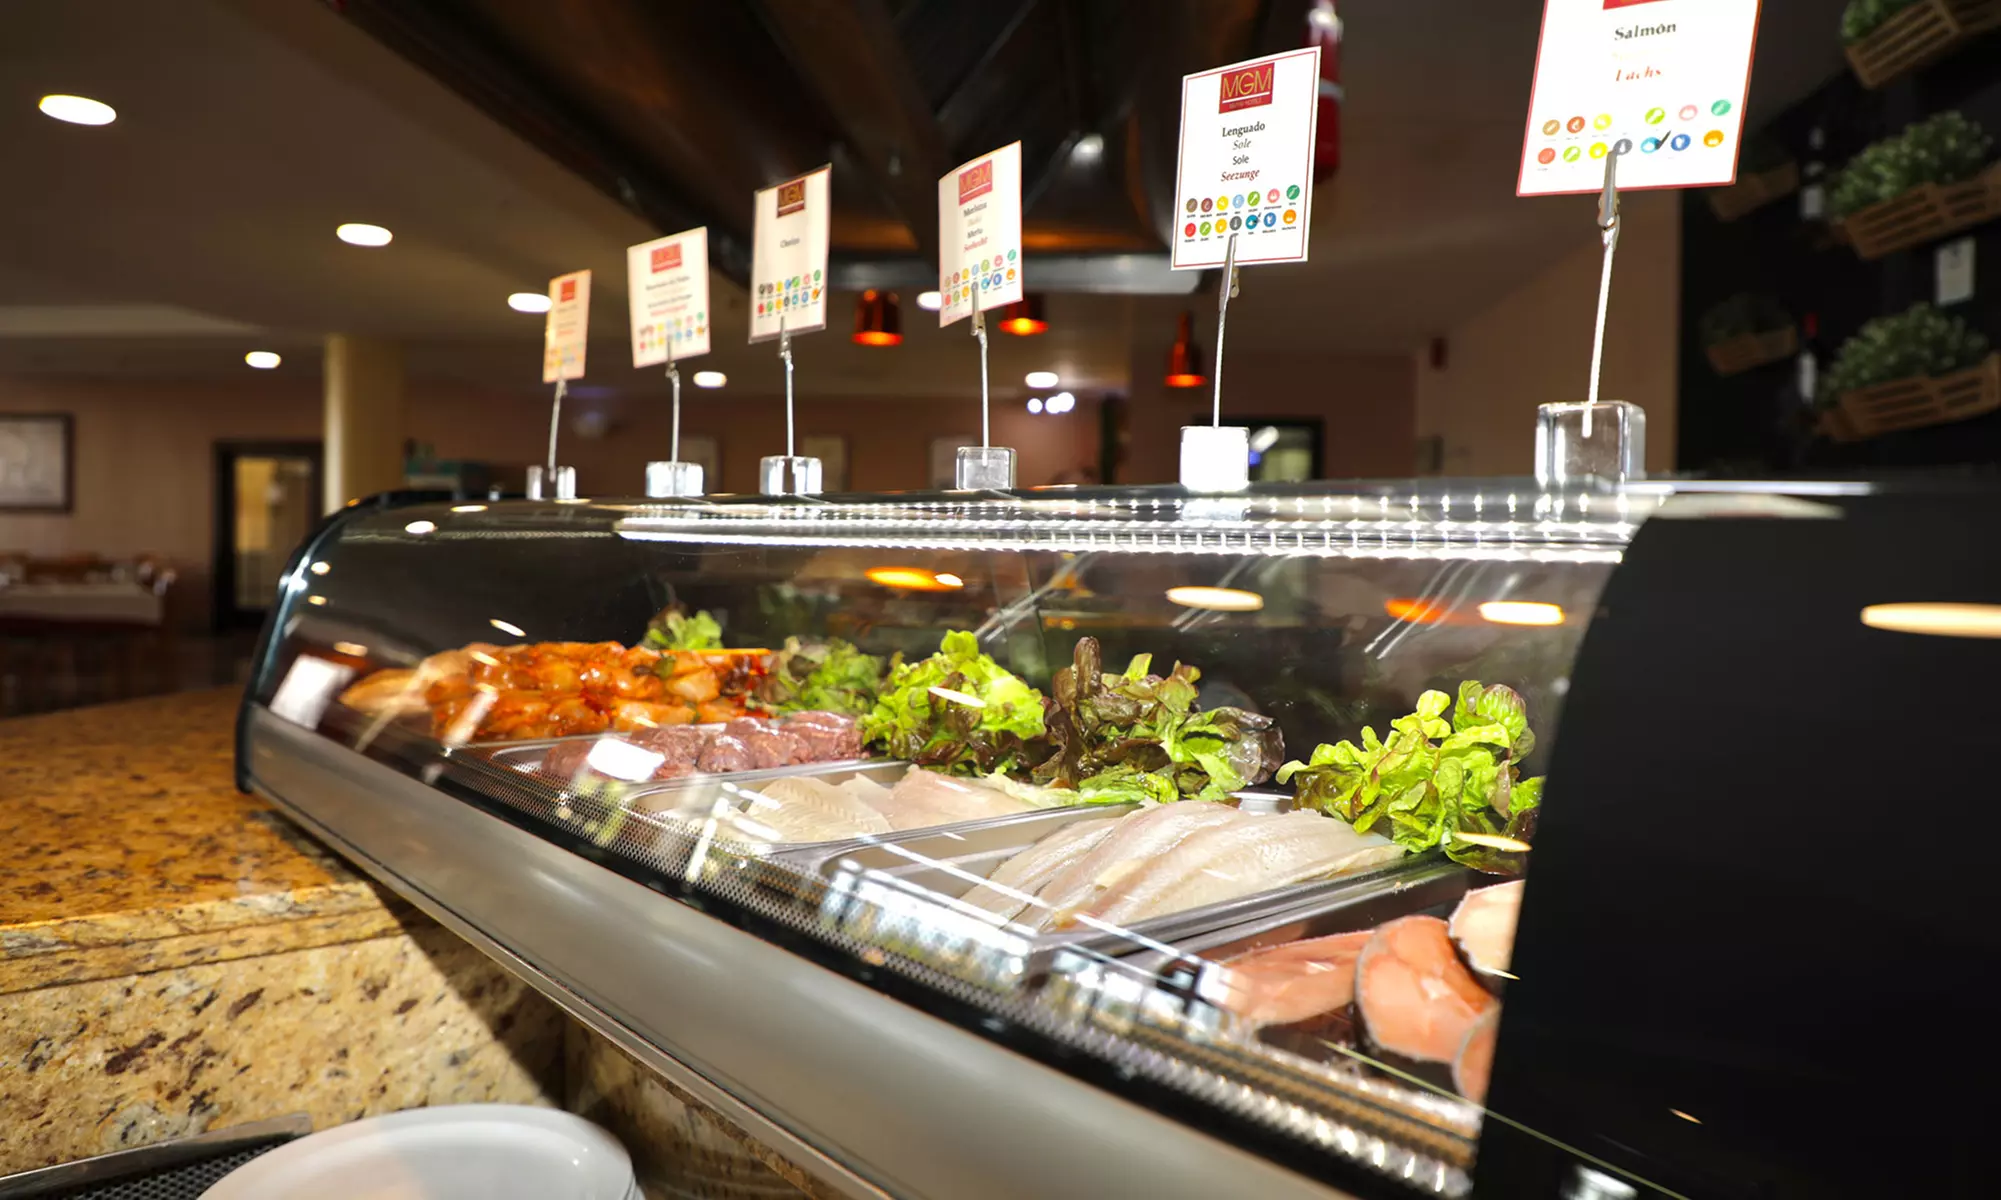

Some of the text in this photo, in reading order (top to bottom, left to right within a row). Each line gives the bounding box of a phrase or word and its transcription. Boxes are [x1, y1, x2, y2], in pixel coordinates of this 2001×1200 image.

[1613, 23, 1677, 41] Salmón
[1222, 67, 1272, 100] MGM
[1221, 121, 1266, 138] Lenguado
[1232, 138, 1252, 151] Sole
[1232, 154, 1250, 166] Sole
[1220, 168, 1260, 182] Seezunge
